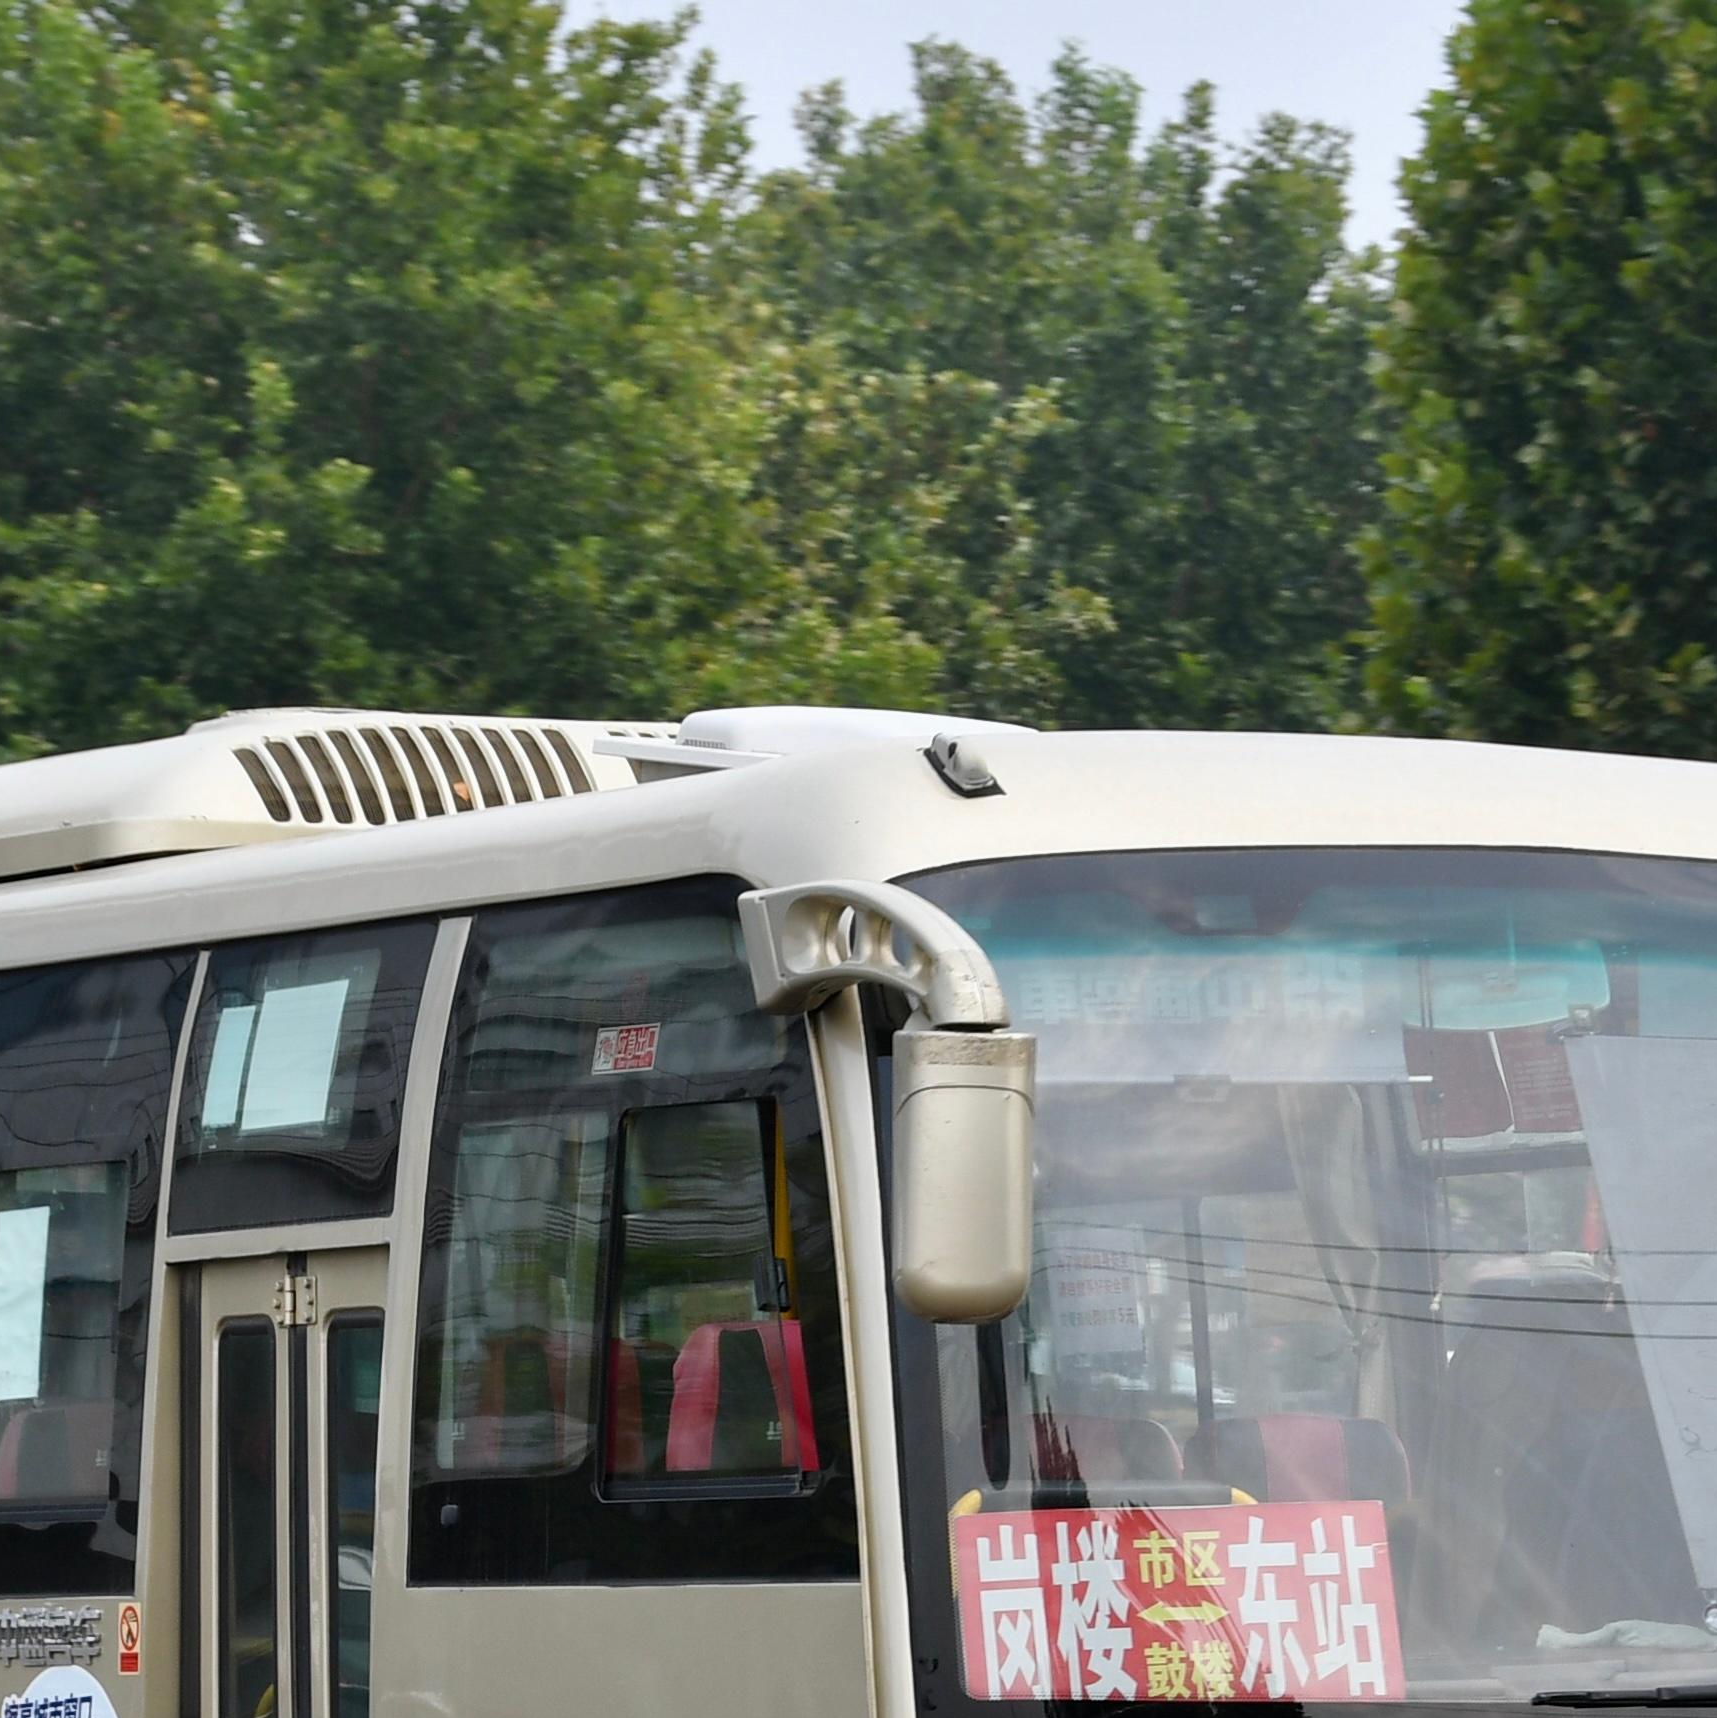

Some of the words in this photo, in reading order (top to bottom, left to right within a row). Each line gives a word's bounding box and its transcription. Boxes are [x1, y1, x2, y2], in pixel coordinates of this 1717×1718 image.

[615, 1028, 659, 1059] 应急出口
[1132, 1530, 1226, 1589] 市区
[976, 1519, 1138, 1701] 岗楼
[1227, 1515, 1386, 1698] 东站
[1143, 1640, 1237, 1701] 鼓楼
